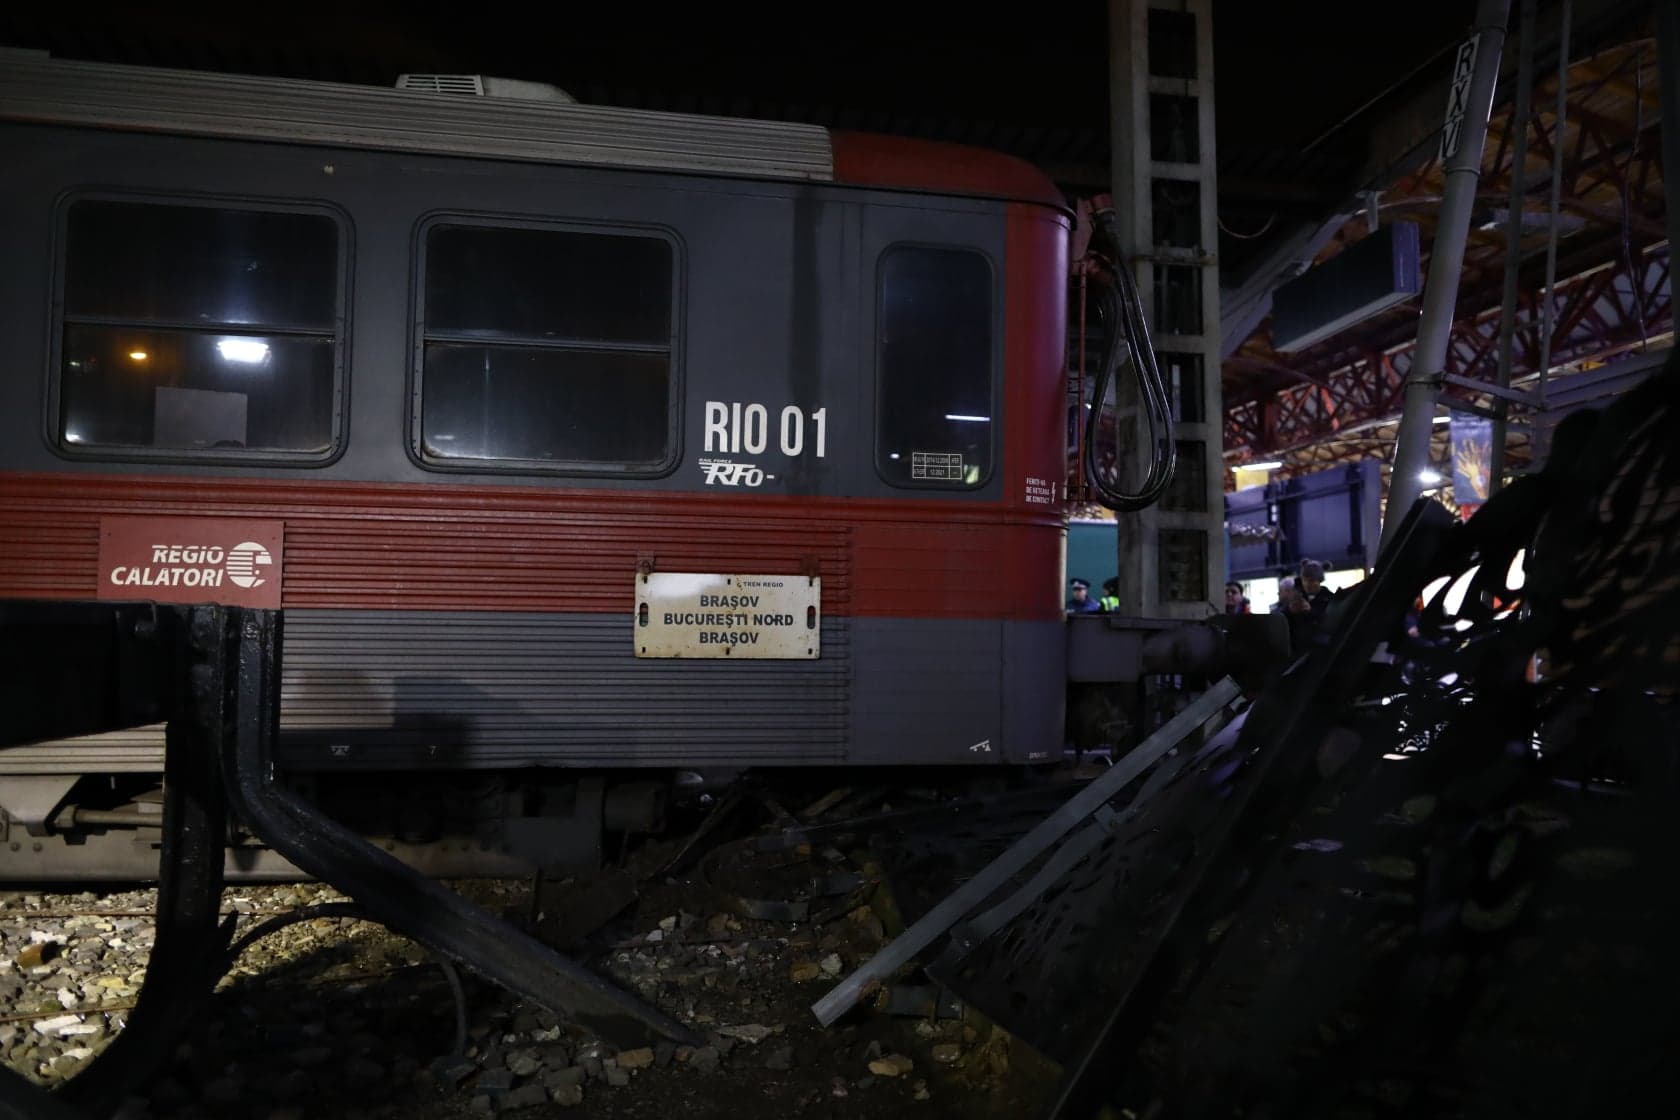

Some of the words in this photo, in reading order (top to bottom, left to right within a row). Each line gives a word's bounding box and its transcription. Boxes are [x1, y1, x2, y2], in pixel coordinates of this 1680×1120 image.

[704, 401, 768, 455] RIO
[780, 405, 826, 458] 01
[152, 544, 224, 565] REGIO
[753, 615, 794, 626] NORD
